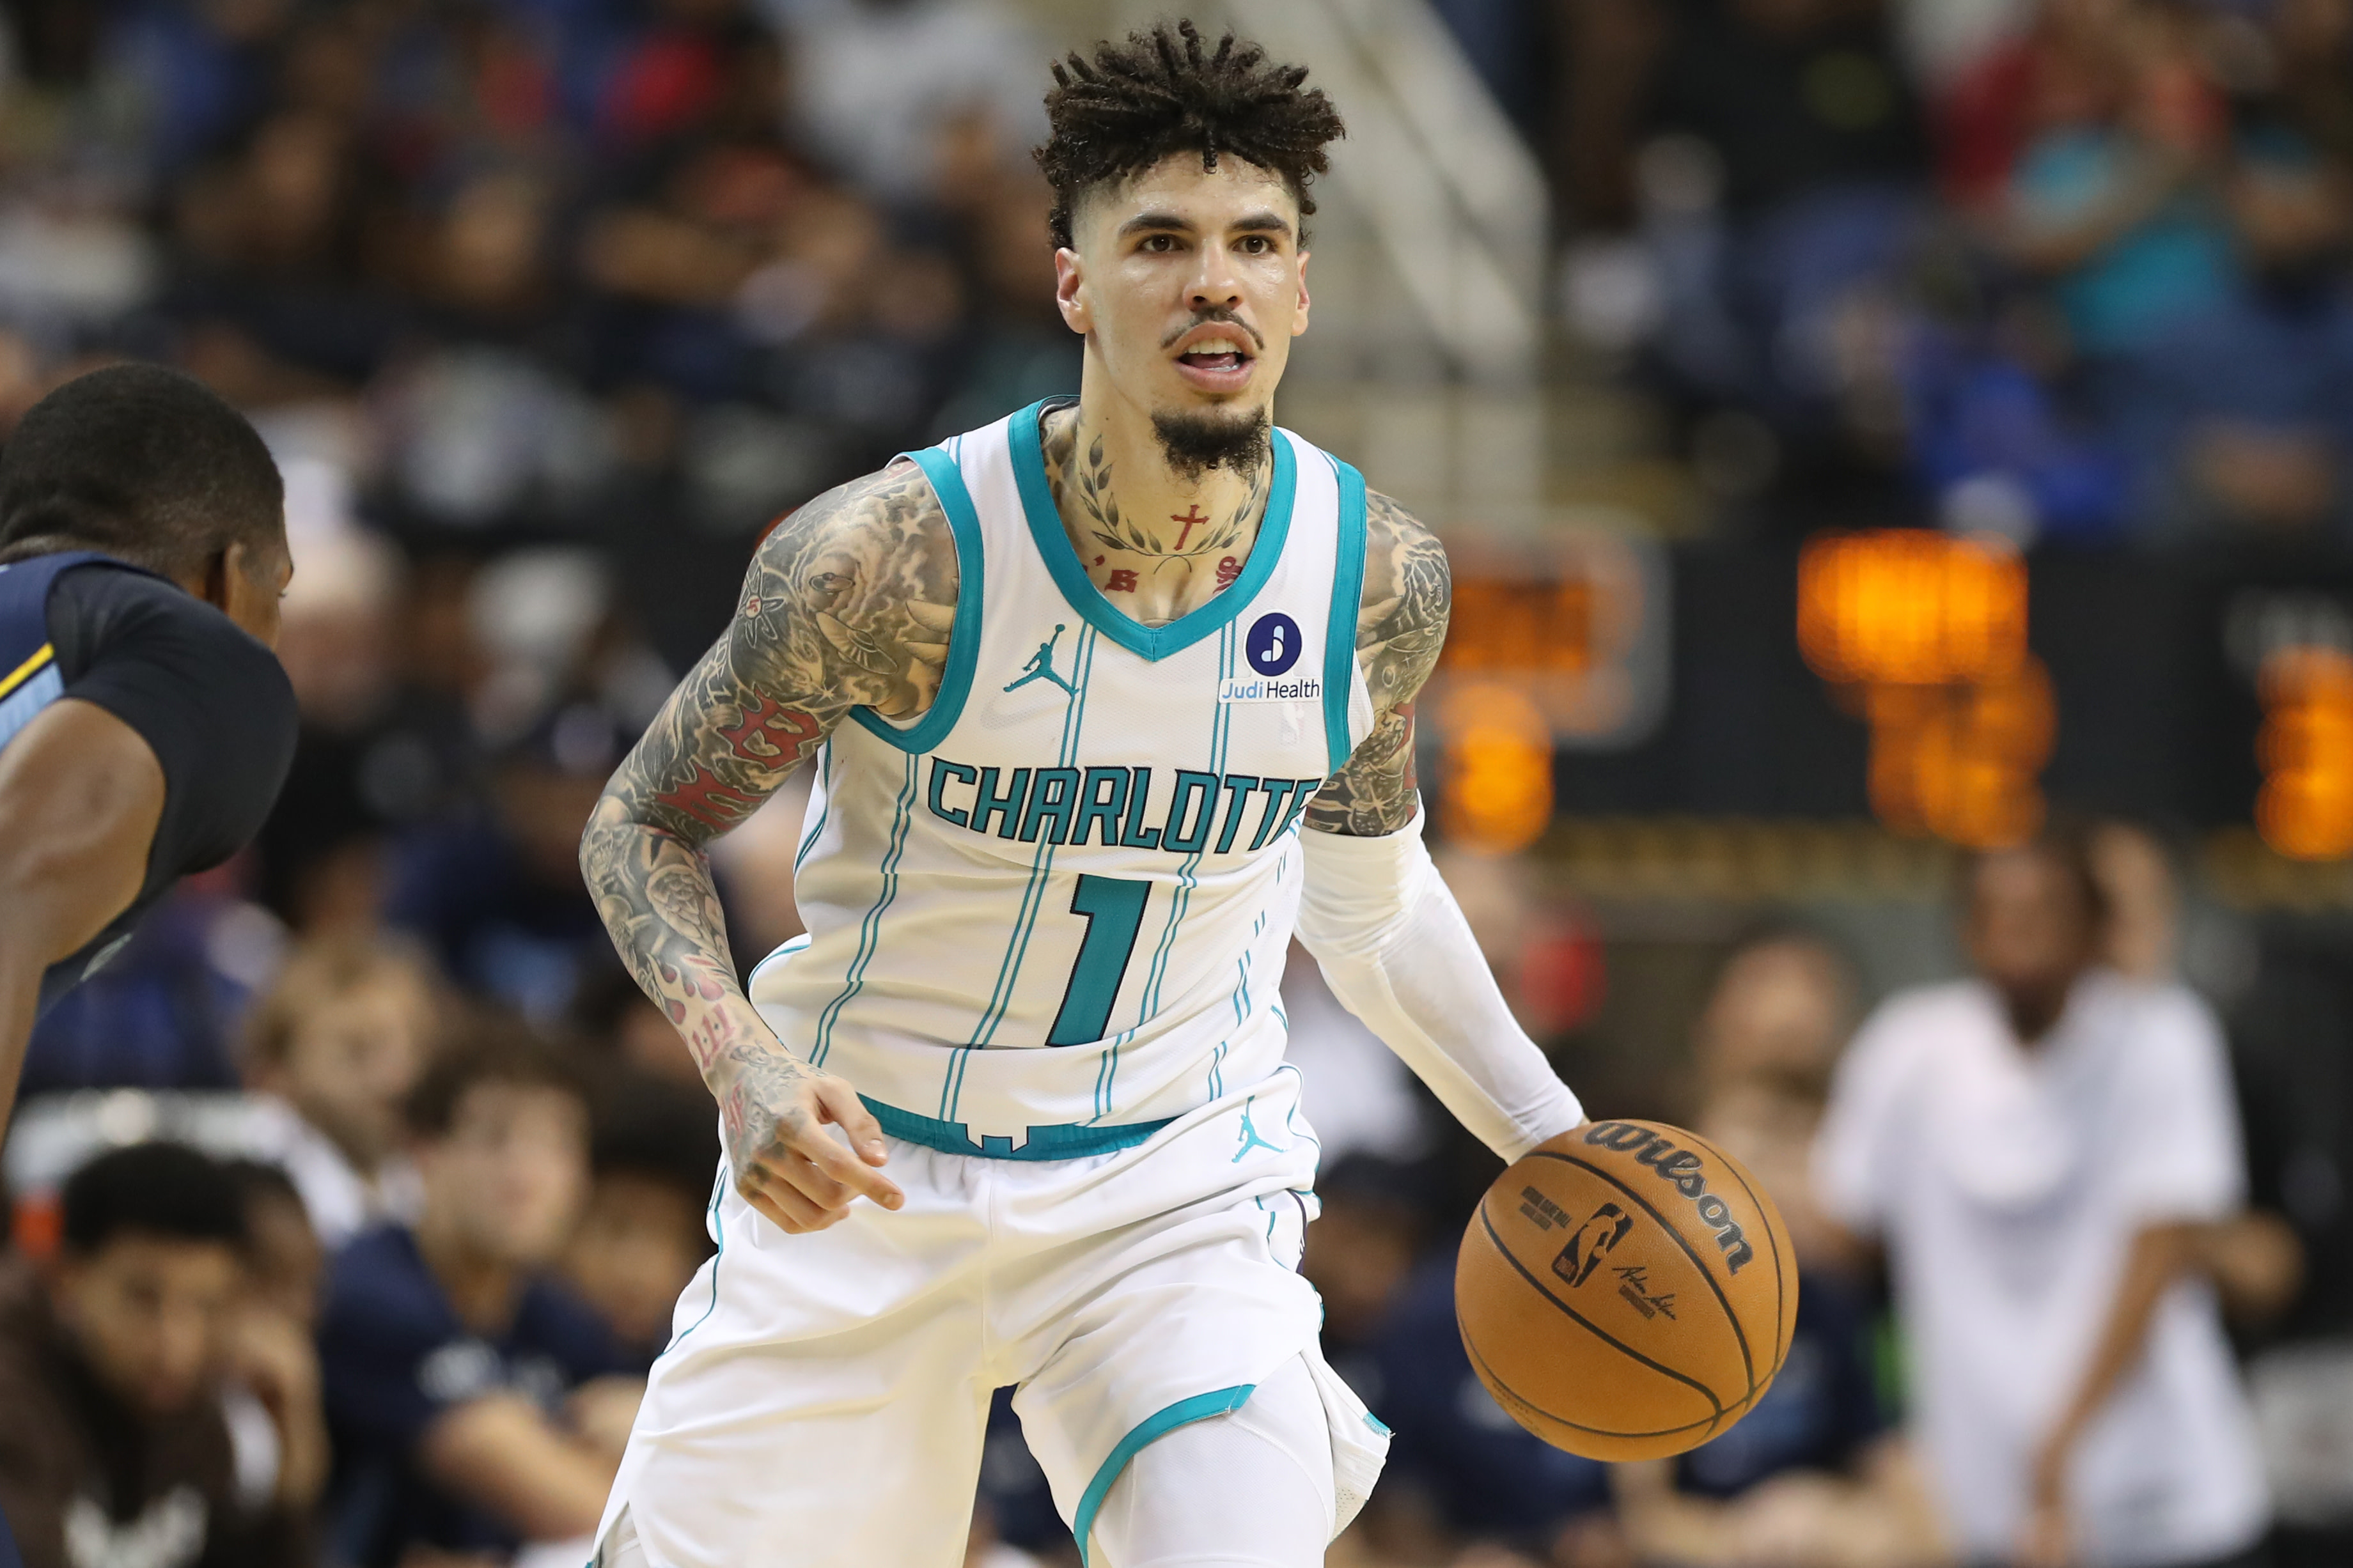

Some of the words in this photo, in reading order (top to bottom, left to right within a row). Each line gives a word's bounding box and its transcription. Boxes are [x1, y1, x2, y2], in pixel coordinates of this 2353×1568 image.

[1222, 681, 1263, 699] Judi
[1266, 679, 1320, 699] Health
[927, 756, 1322, 855] CHARLOTTE
[1045, 873, 1153, 1047] 1
[1583, 1122, 1753, 1277] Wilson
